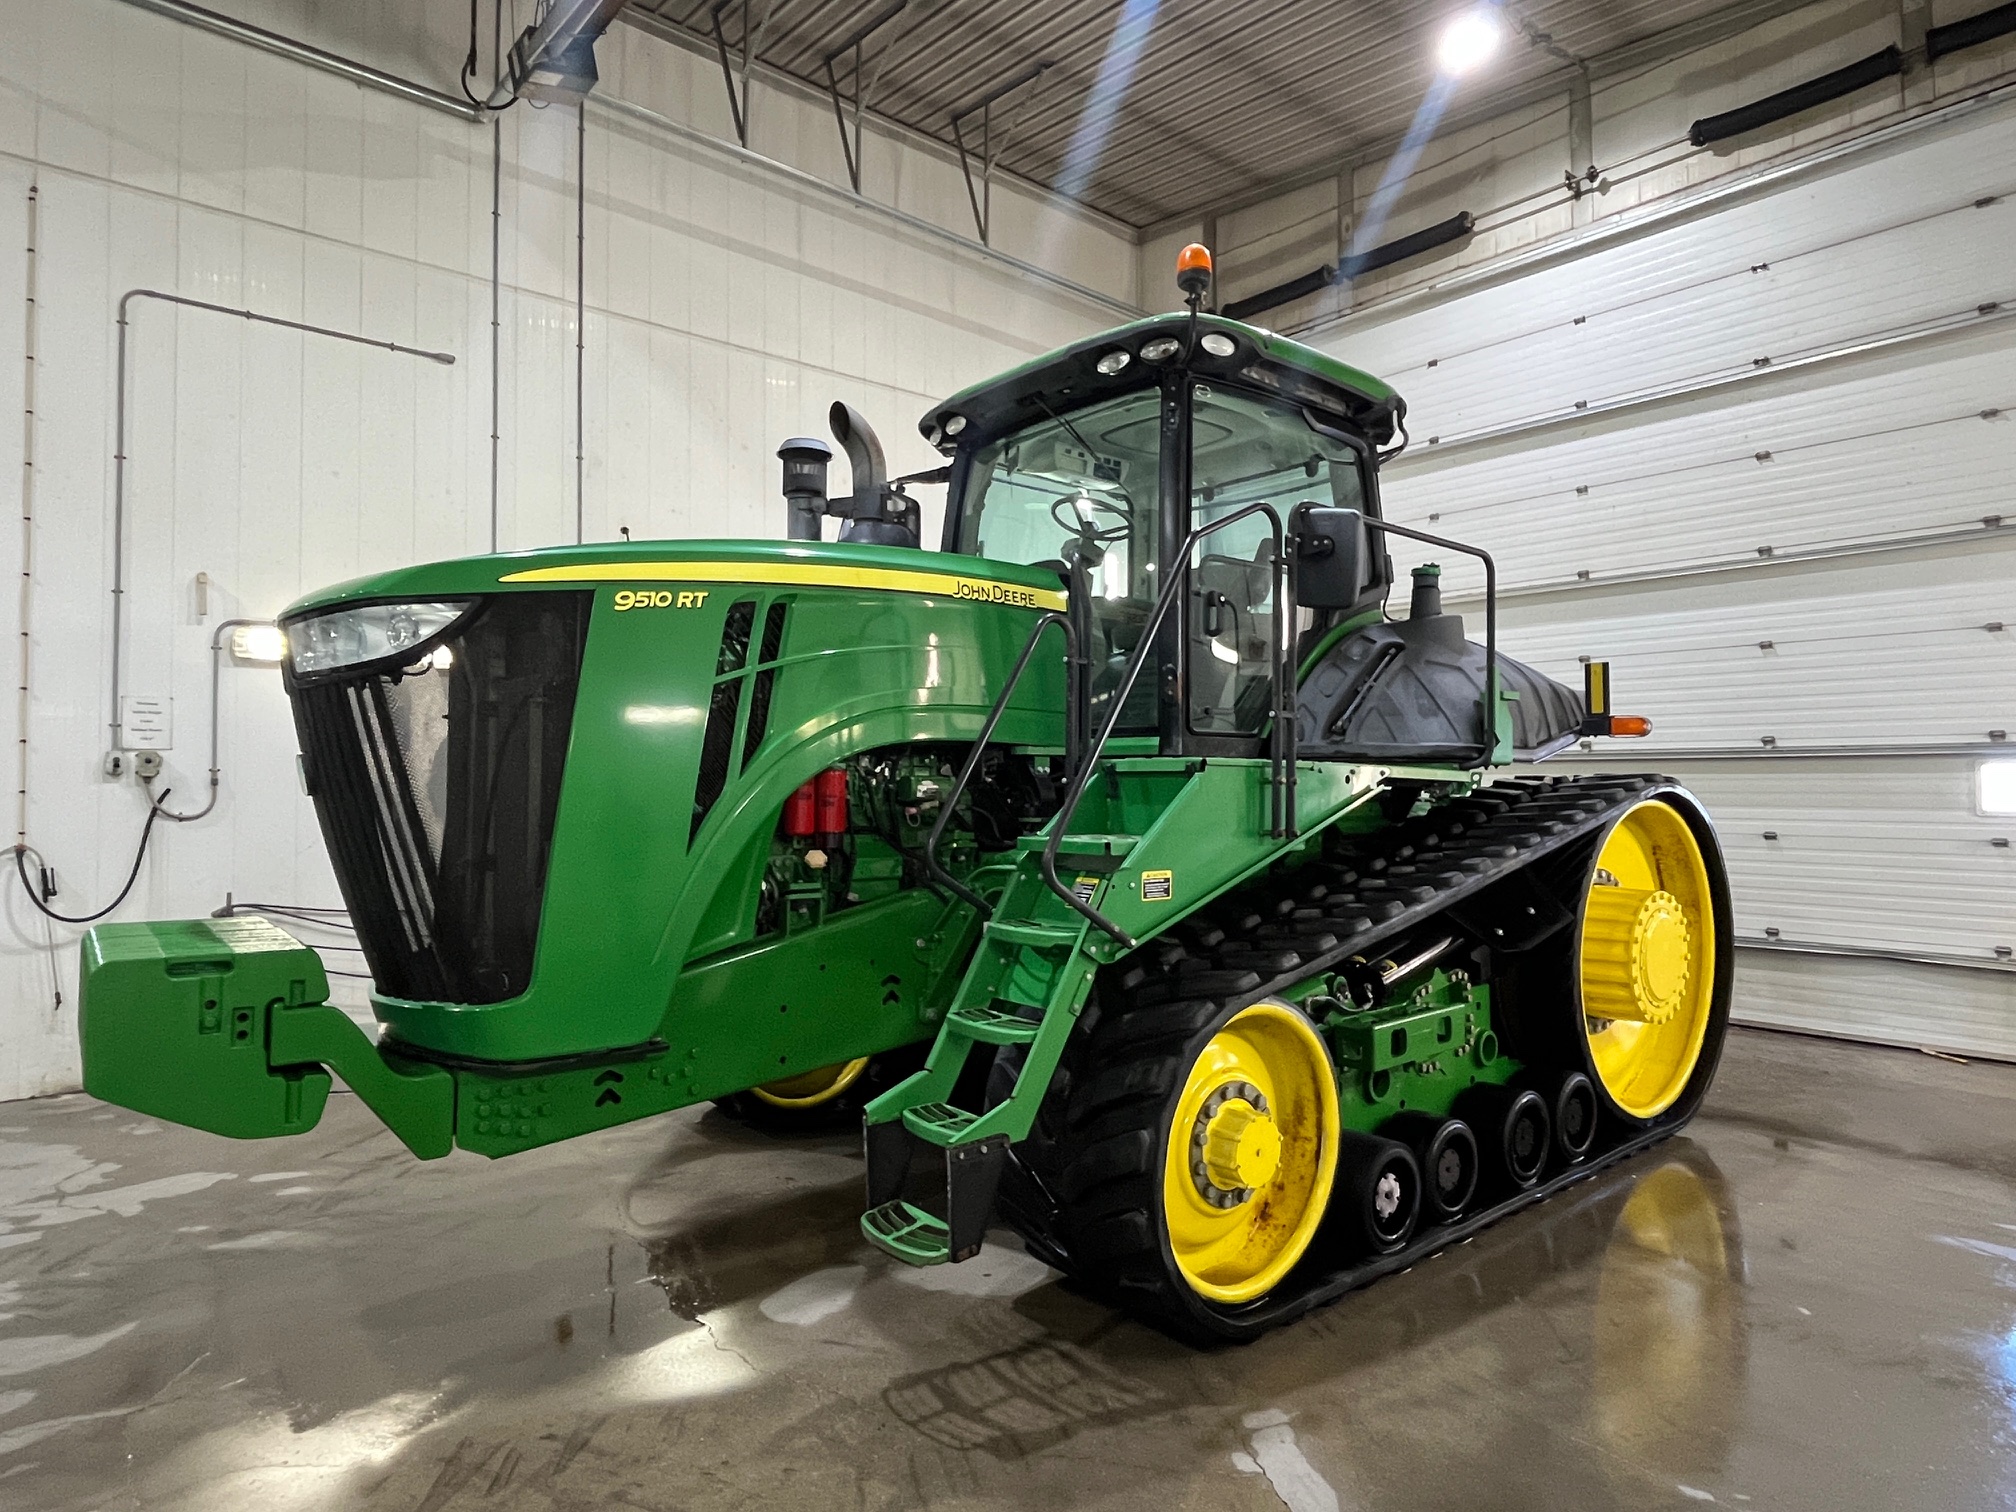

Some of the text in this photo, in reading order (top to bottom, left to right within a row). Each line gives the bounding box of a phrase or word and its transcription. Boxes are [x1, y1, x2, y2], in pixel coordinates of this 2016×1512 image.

[614, 590, 709, 611] 9510 RT
[953, 580, 1036, 606] JOHN DEERE
